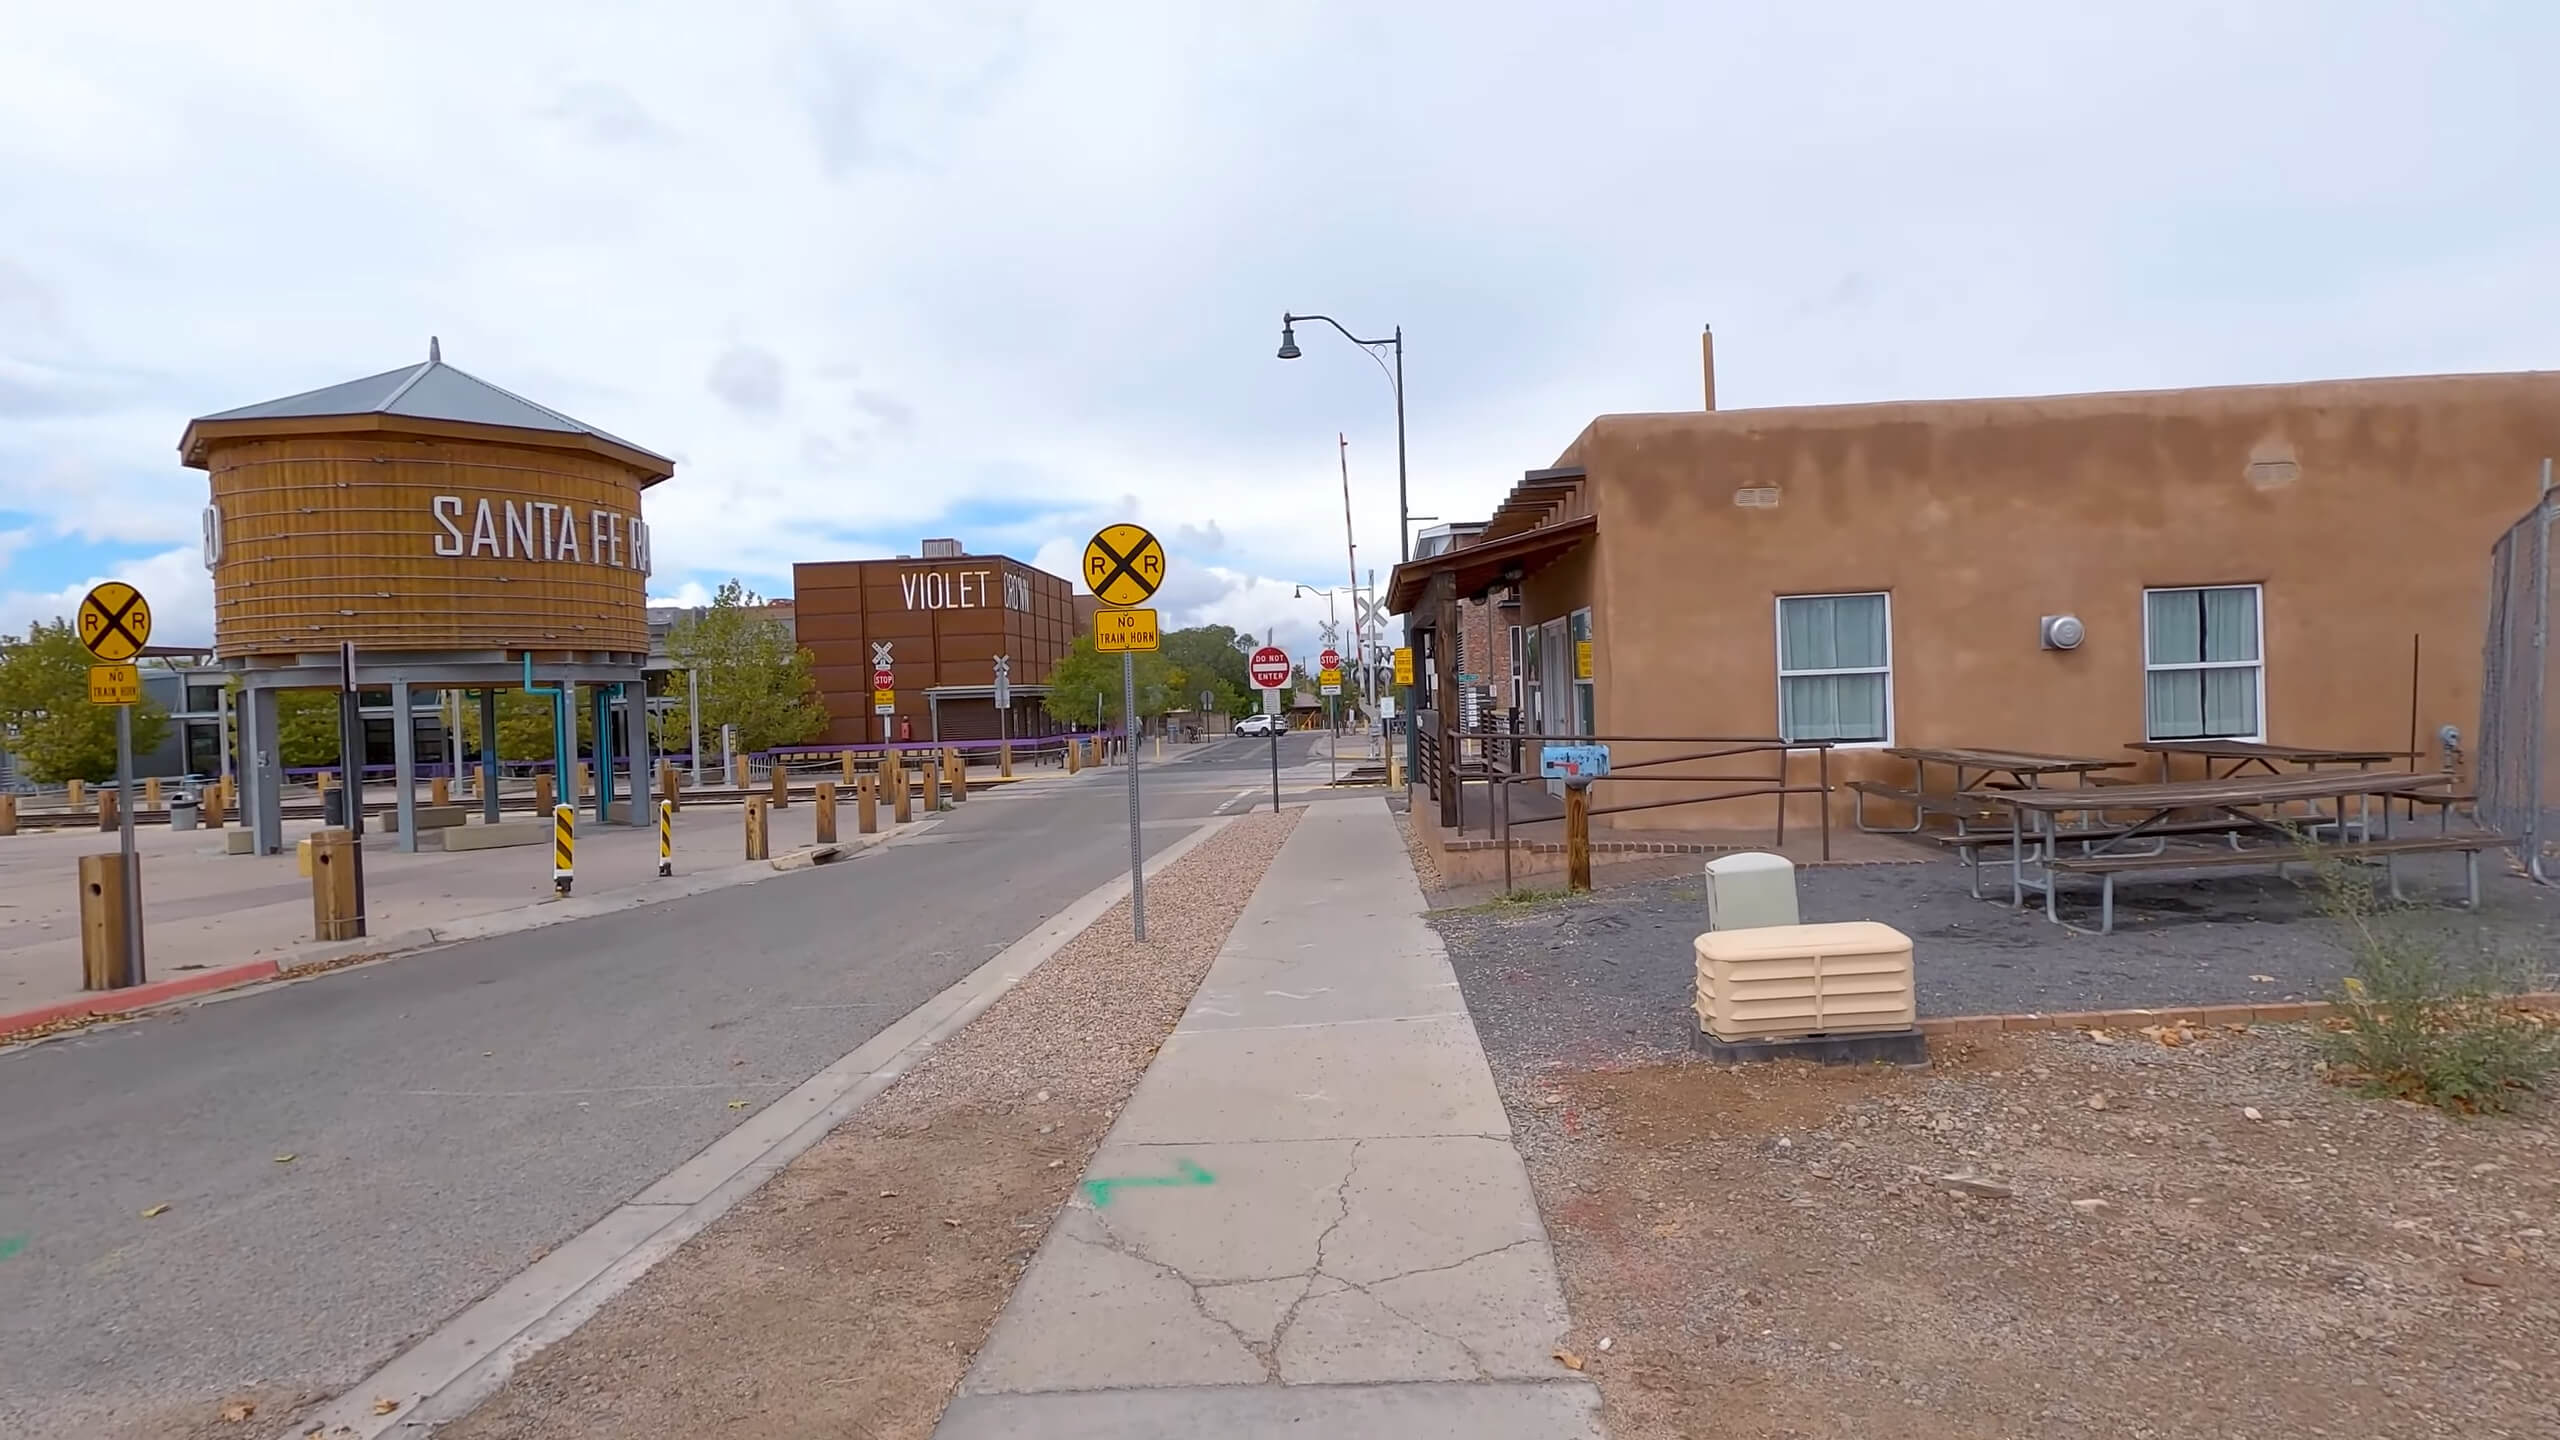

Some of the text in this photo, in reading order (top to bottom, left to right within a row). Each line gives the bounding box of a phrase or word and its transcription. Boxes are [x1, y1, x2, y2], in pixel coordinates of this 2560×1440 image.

[433, 496, 581, 562] SANTA
[591, 509, 624, 567] FE
[1091, 555, 1159, 575] R R
[901, 571, 991, 610] VIOLET
[85, 612, 145, 631] R R
[1117, 617, 1135, 627] NO
[1100, 632, 1154, 644] TRAIN HORN
[1321, 655, 1339, 664] STOP
[109, 672, 124, 682] NO
[875, 676, 893, 684] STOP
[1257, 672, 1284, 680] ENTER
